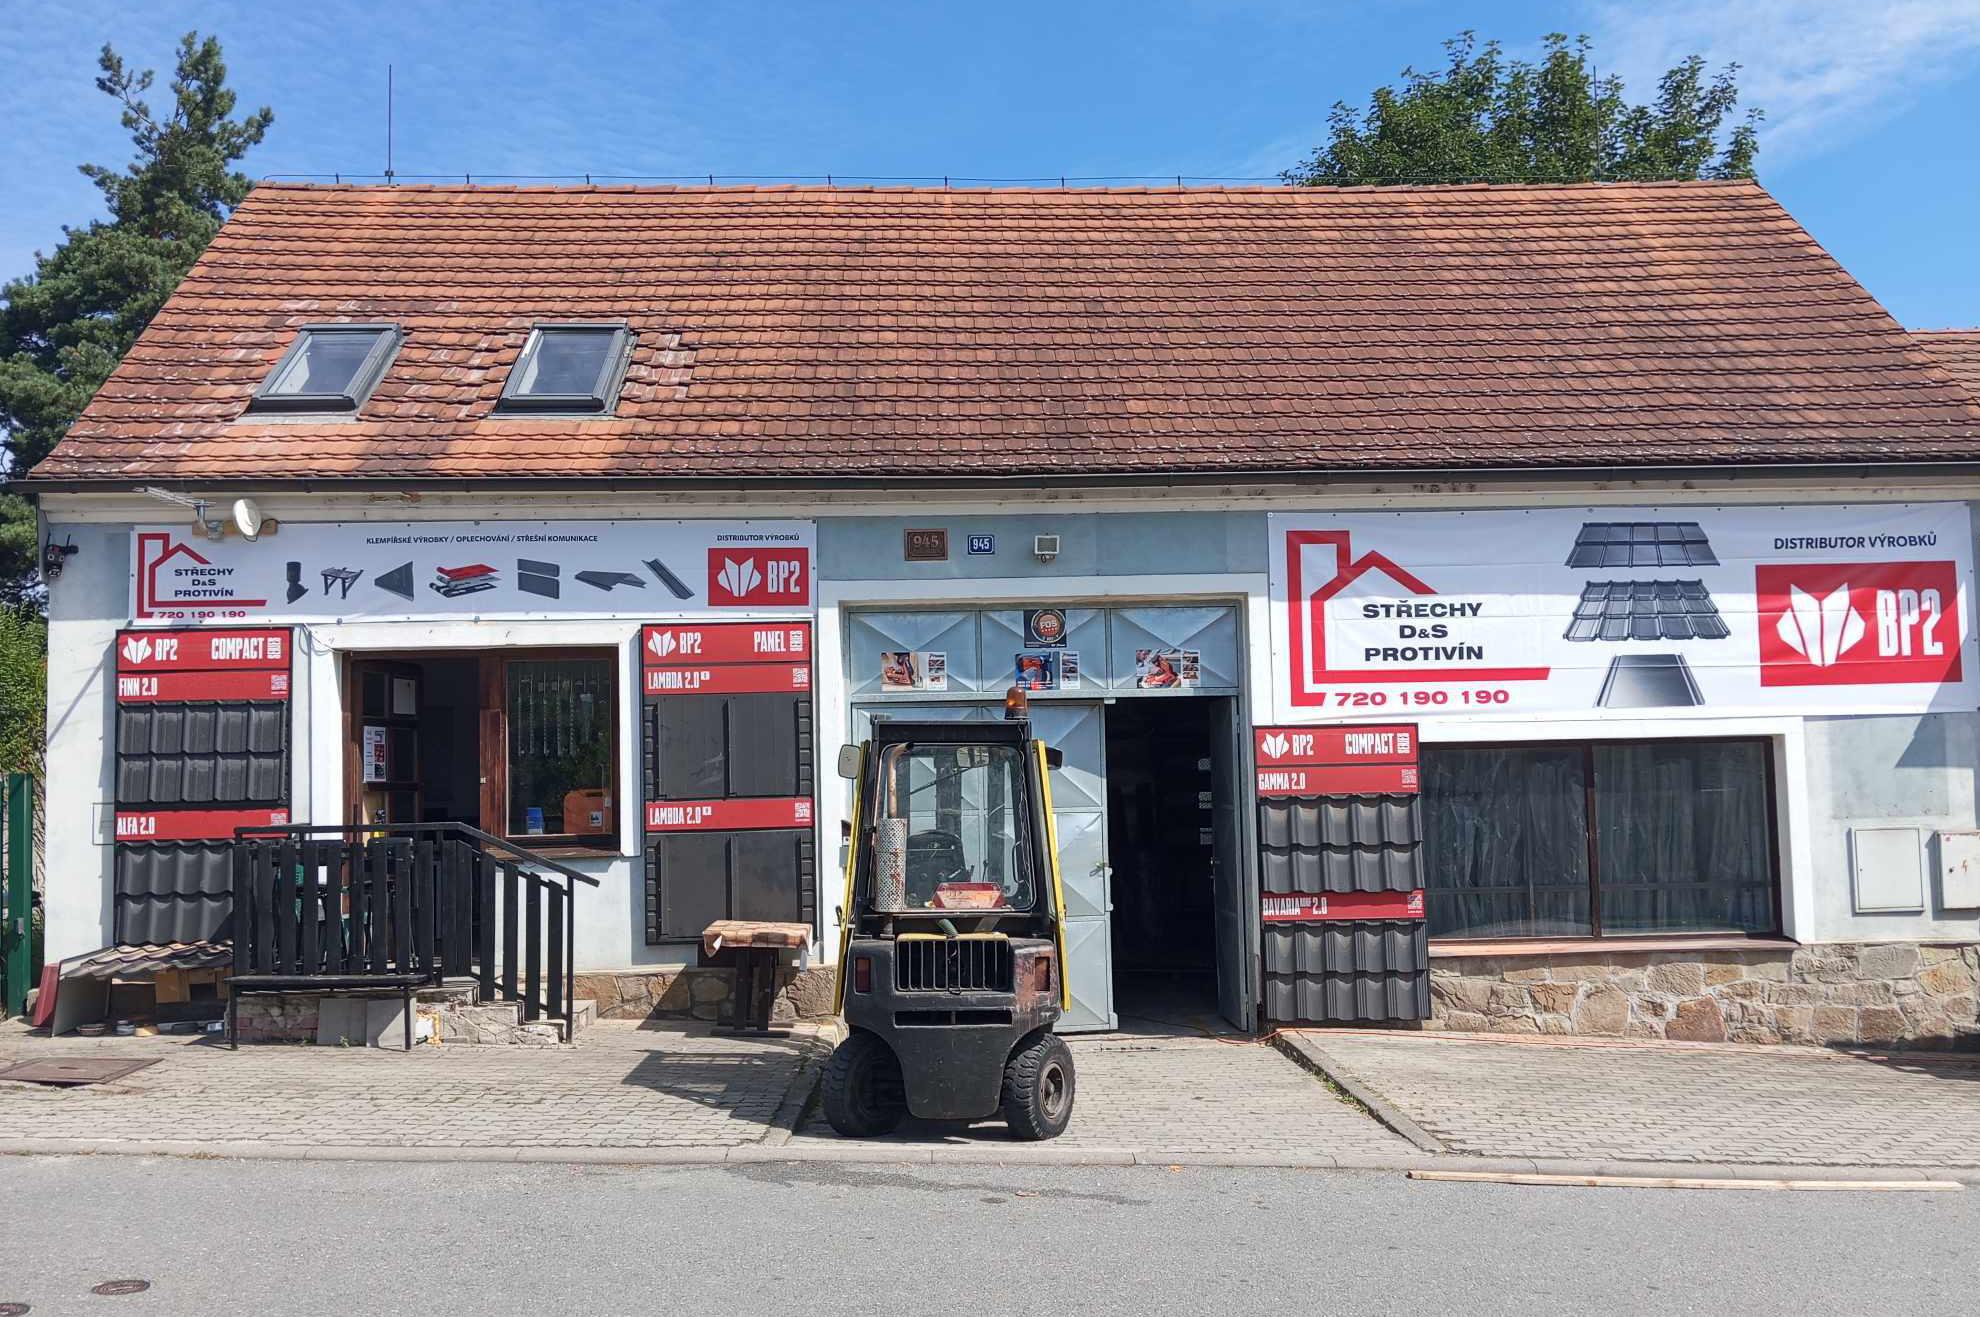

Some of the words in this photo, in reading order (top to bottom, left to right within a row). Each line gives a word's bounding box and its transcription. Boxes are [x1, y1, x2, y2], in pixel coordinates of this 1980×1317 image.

[456, 534, 510, 542] OPLECHOVÁNÍ
[516, 534, 547, 542] STŘEŠNÍ
[548, 534, 599, 542] KOMUNIKACE
[764, 531, 800, 541] VÝROBKŮ
[912, 534, 939, 547] 945
[972, 538, 990, 550] 945
[1773, 536, 1866, 550] DISTRIBUTOR
[1869, 531, 1937, 548] VÝROBKŮ
[174, 566, 235, 577] STŘECHY
[767, 560, 801, 593] BP2
[191, 578, 217, 587] D&S
[174, 587, 235, 598] PROTIVÍN
[158, 611, 185, 619] 720
[221, 610, 247, 618] 190
[1362, 600, 1483, 619] STŘECHY
[1399, 623, 1449, 640] D&S
[1875, 588, 1945, 657] BP2
[155, 638, 178, 661] BP2
[211, 637, 265, 660] COMPACT
[679, 632, 702, 654] BP2
[753, 630, 787, 653] PANEL
[1364, 642, 1484, 662] PROTIVÍN
[118, 677, 140, 697] FINN
[141, 677, 158, 696] 2.0
[647, 671, 683, 689] LAMBDA
[684, 671, 700, 689] 2.0
[1334, 691, 1387, 707] 720
[1399, 690, 1449, 706] 190
[1461, 689, 1511, 705] 190
[1292, 734, 1315, 756] BP2
[1344, 732, 1395, 755] COMPACT
[1258, 772, 1290, 791] GAMMA
[1291, 772, 1306, 790] 2.0
[649, 807, 685, 826] LAMBDA
[686, 806, 702, 825] 2.0
[116, 816, 138, 836] ALFA
[139, 816, 156, 835] 2.0
[1262, 896, 1301, 916] BAVARIA
[1311, 896, 1328, 915] 2.0
